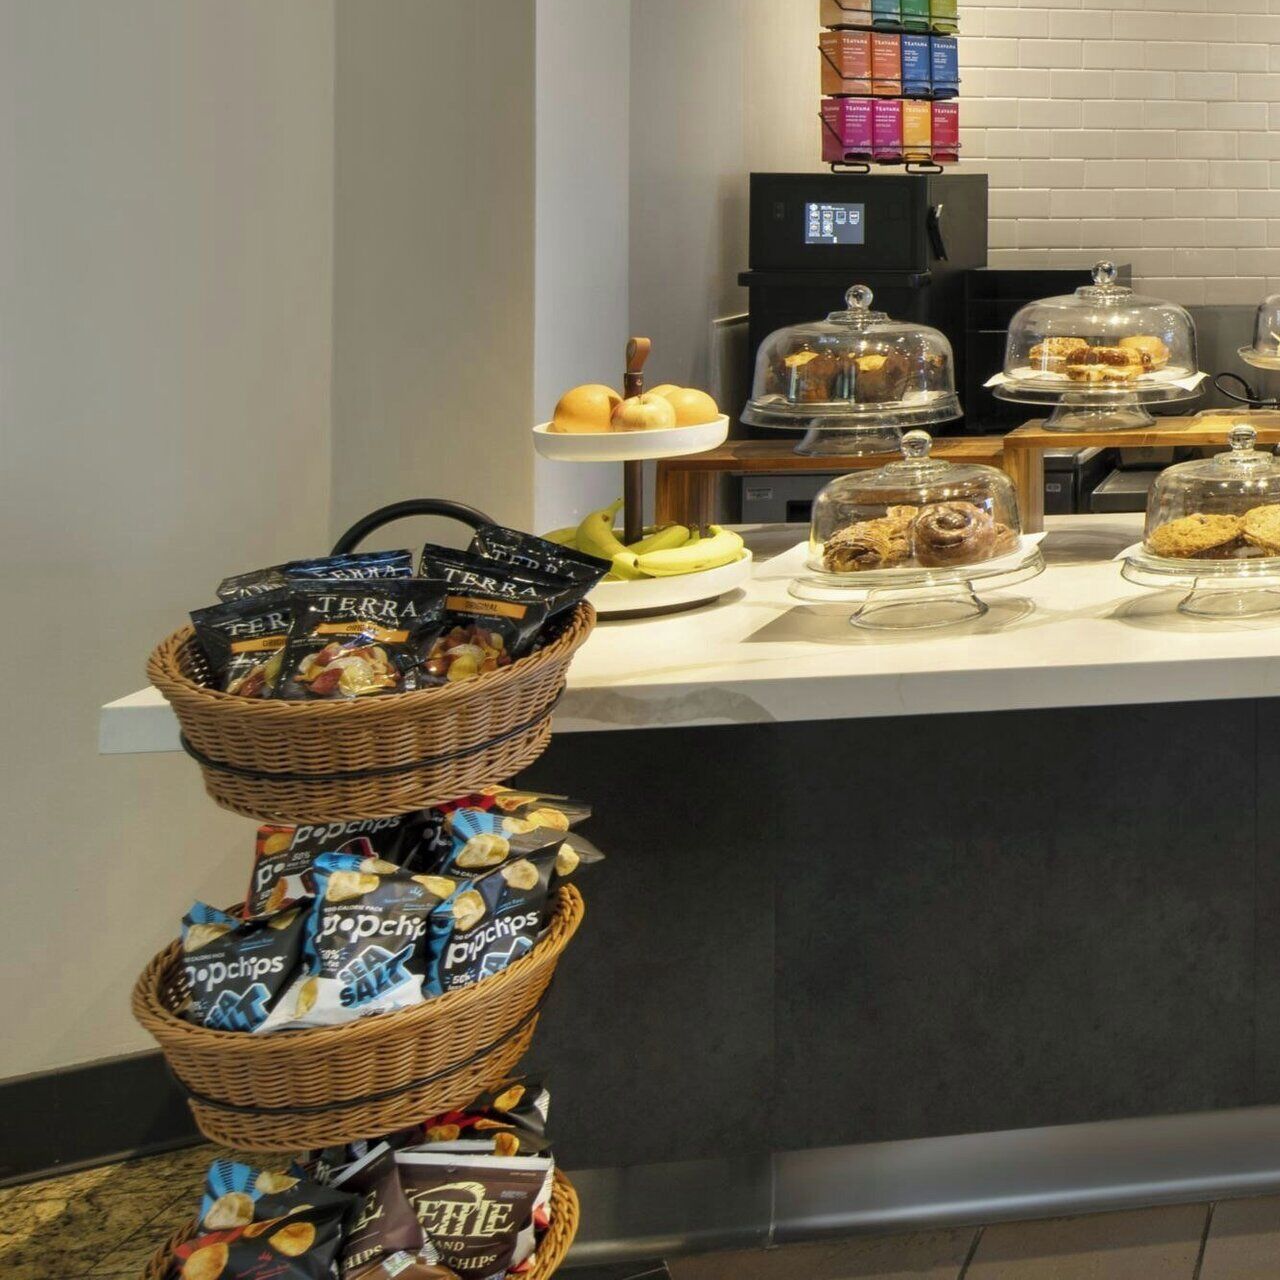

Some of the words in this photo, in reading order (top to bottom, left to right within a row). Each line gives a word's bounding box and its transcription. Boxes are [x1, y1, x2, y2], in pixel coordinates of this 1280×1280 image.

[444, 567, 538, 599] TERRA
[315, 596, 419, 619] TERRA
[225, 612, 292, 636] TER
[290, 816, 402, 851] popchips
[315, 914, 428, 944] popchip
[339, 946, 391, 986] SEA
[340, 944, 415, 1008] SALT
[404, 1181, 516, 1239] ETTLE
[344, 1244, 384, 1272] HIPS
[449, 1253, 498, 1272] CHIPS
